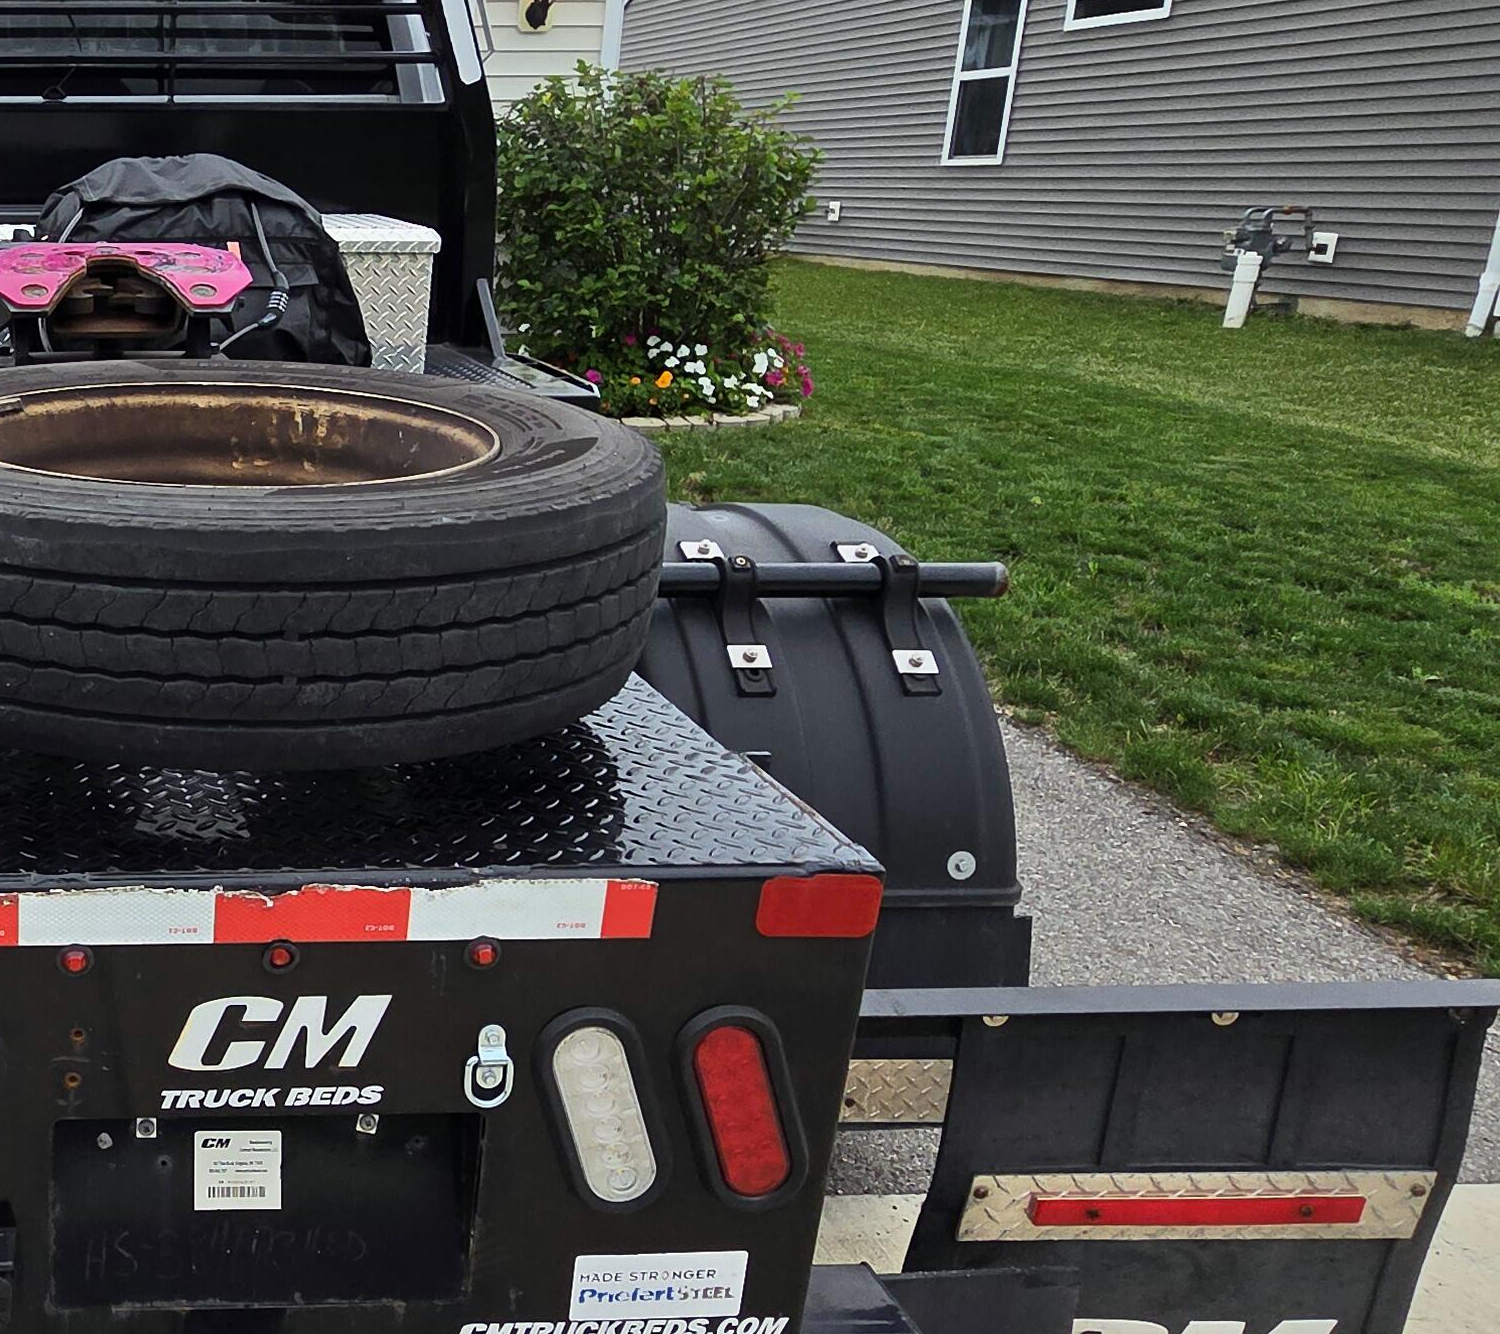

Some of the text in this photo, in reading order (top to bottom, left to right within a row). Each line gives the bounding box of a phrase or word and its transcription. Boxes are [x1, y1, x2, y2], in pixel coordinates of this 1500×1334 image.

[167, 995, 393, 1071] CM
[160, 1085, 385, 1110] TRUCK BEDS
[201, 1138, 231, 1149] CM
[579, 1269, 717, 1283] MADE STRONGER
